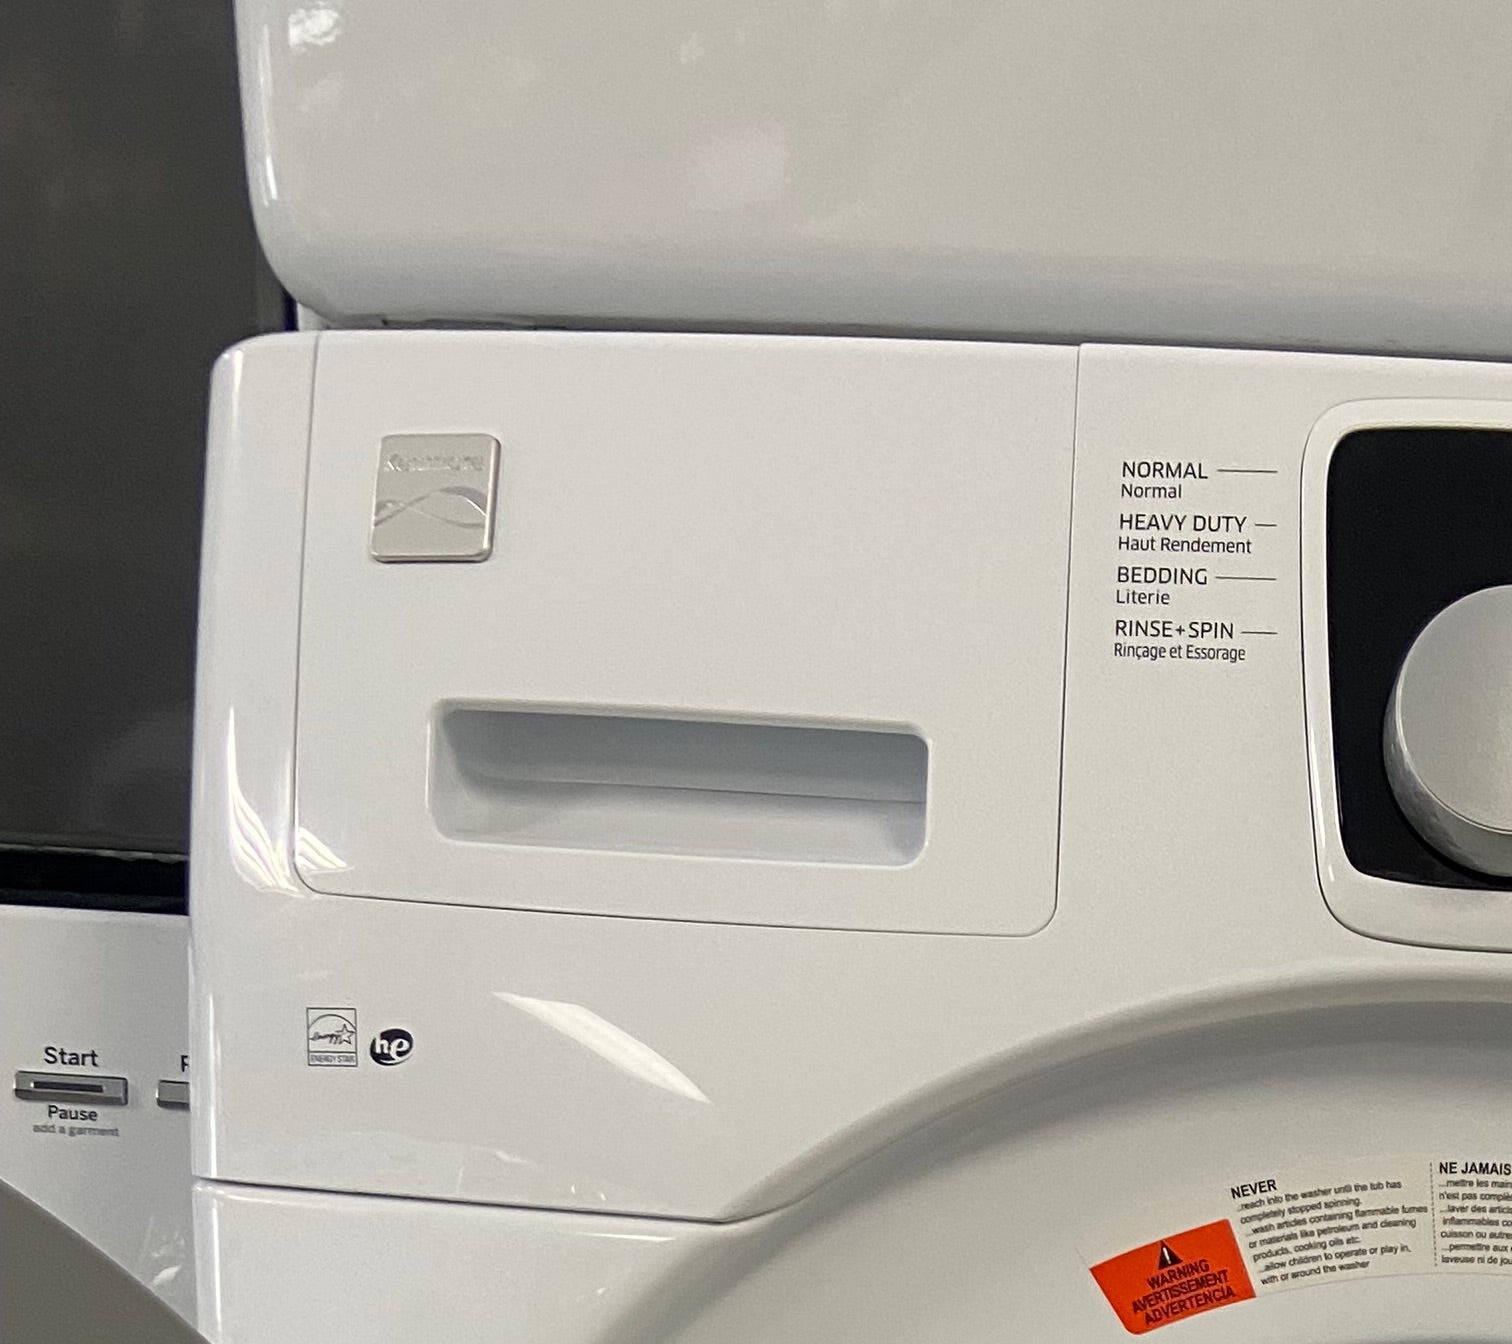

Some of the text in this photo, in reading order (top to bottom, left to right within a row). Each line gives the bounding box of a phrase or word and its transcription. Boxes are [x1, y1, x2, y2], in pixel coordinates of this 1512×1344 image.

[1123, 462, 1208, 479] NORMAL
[1122, 484, 1181, 498] Normal
[1120, 514, 1247, 532] HEAVY DUTY
[1119, 536, 1251, 554] Haut Rendement
[1118, 567, 1207, 585] BEDDING
[1117, 589, 1169, 605] Literie
[1116, 620, 1233, 639] RINSE+SPIN
[1115, 643, 1245, 663] Rinçage et Essorage
[44, 1047, 98, 1067] Start
[48, 1105, 97, 1121] Pause
[1440, 1162, 1511, 1175] NE JAMAIS
[1231, 1179, 1276, 1199] NEVER
[1146, 1259, 1210, 1290] WARNING
[1132, 1269, 1229, 1314] AVERTISSEMENT
[1145, 1286, 1235, 1325] ADVERTENCIA
